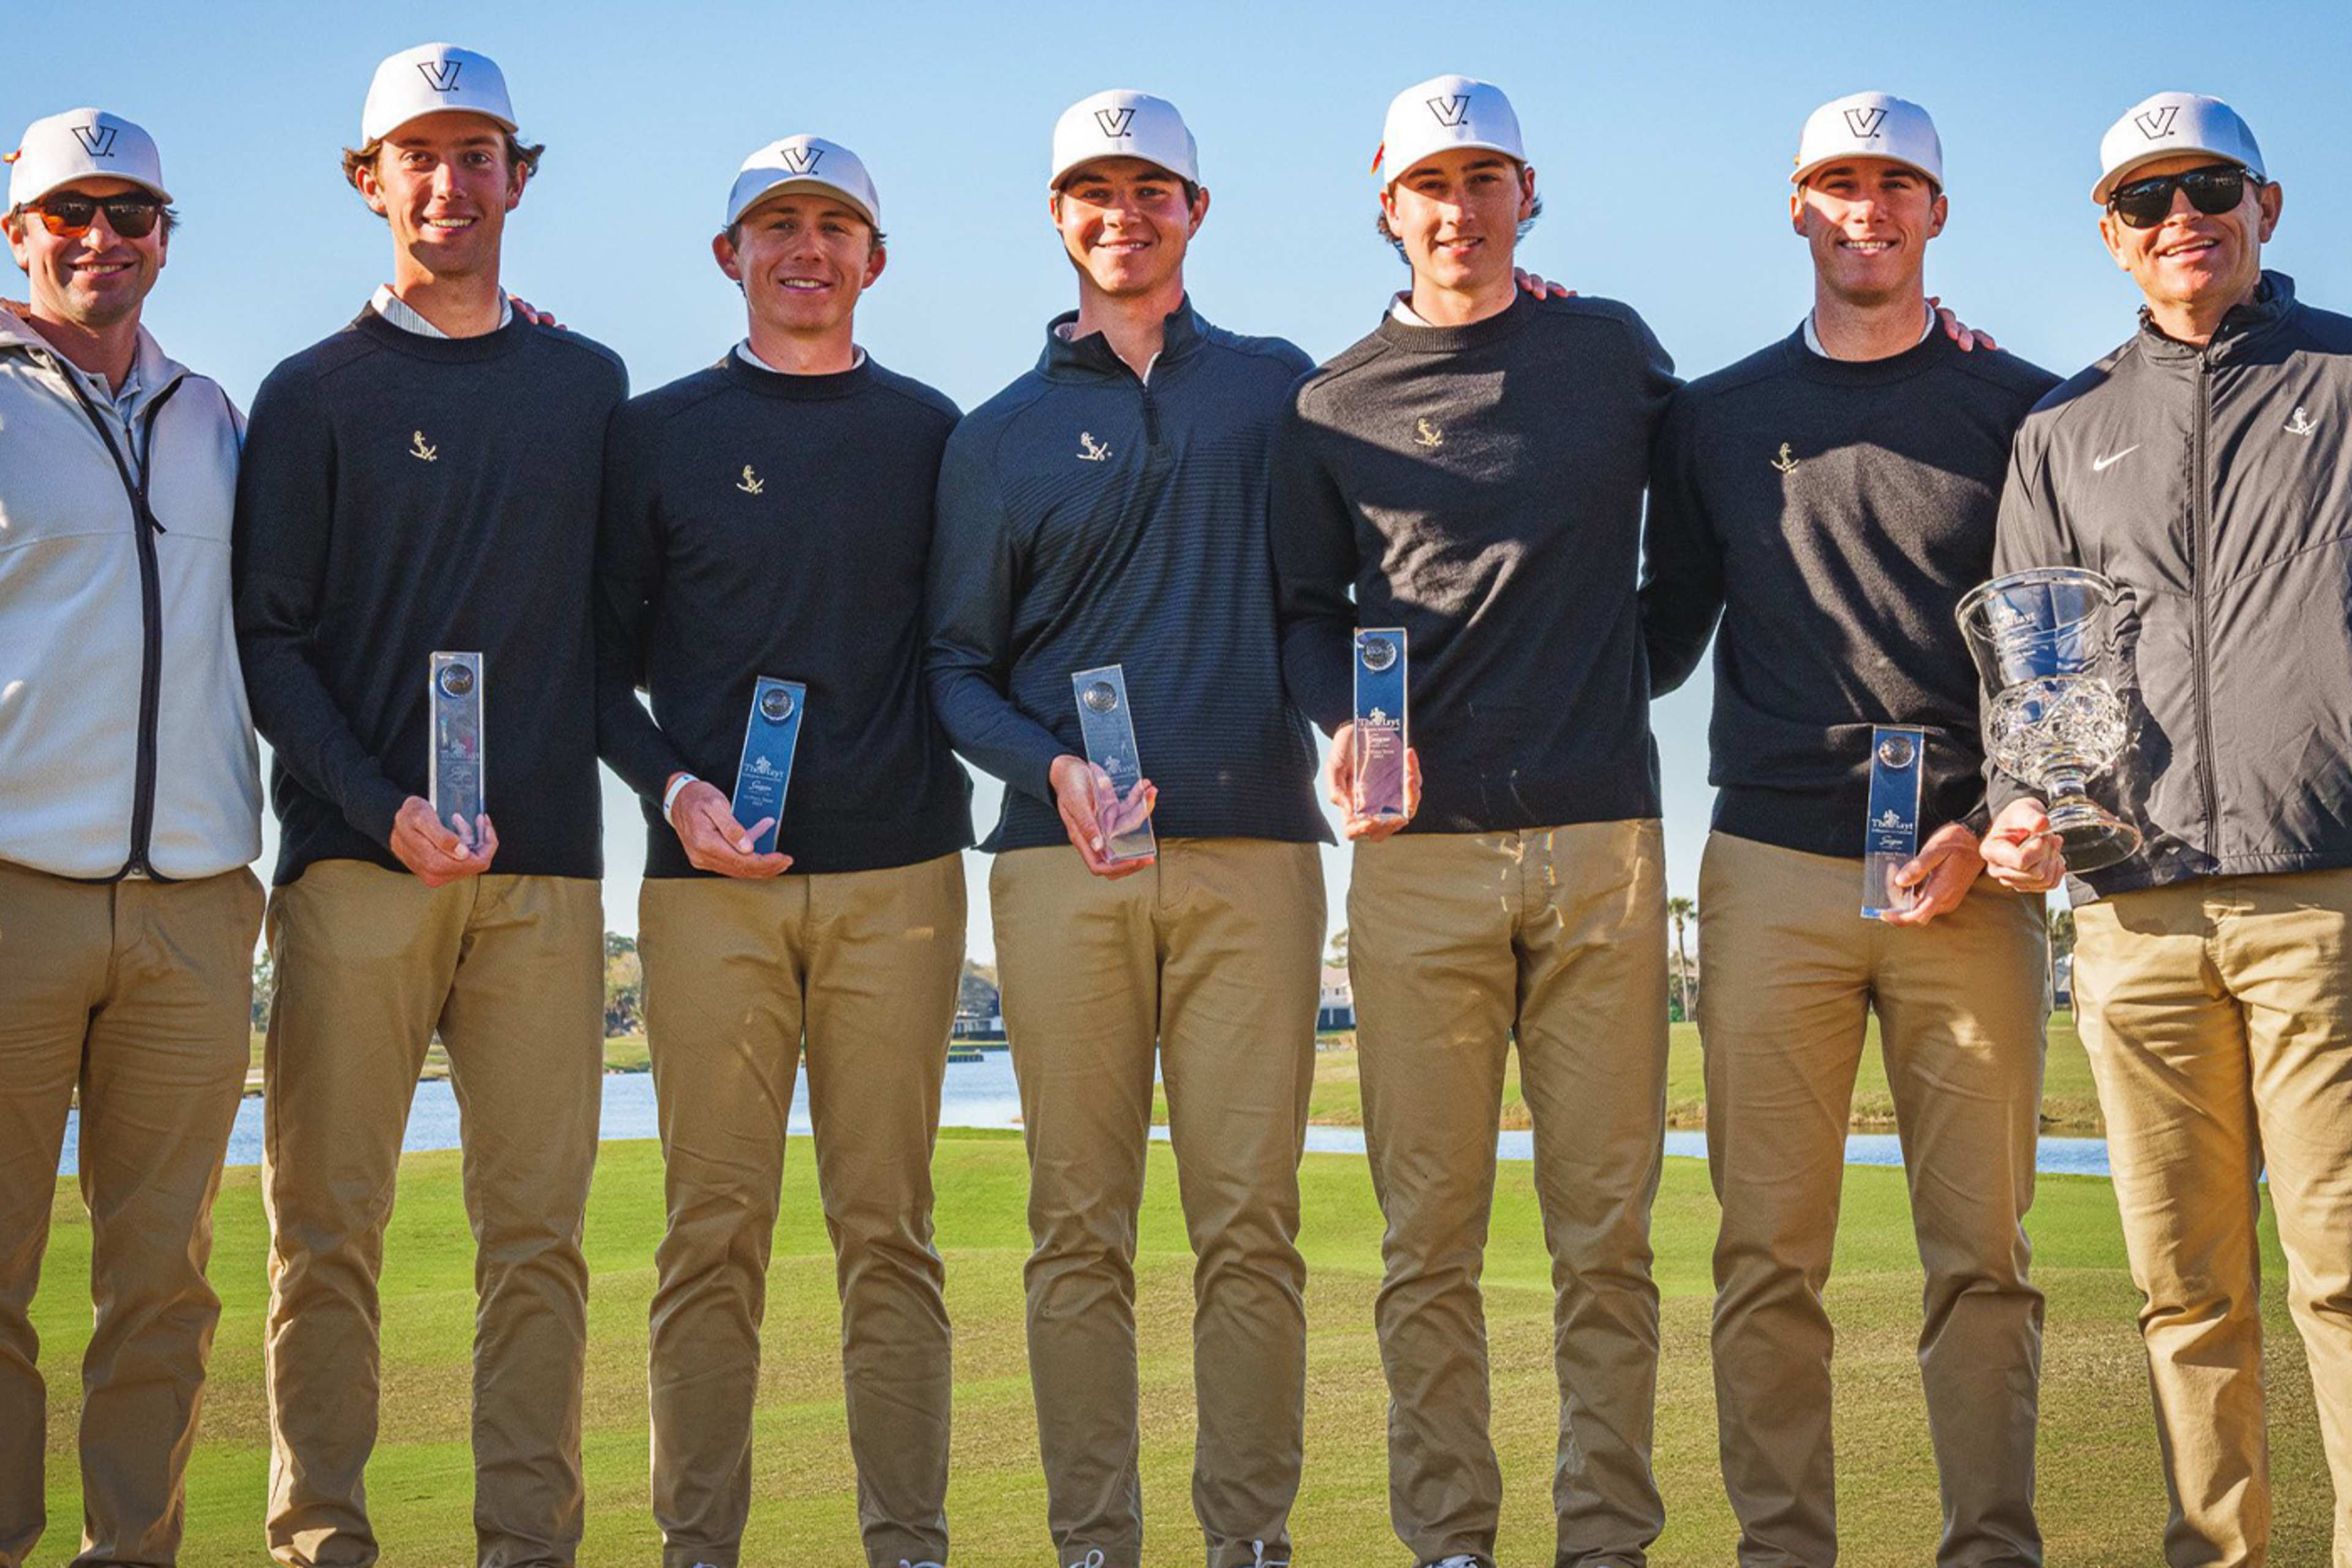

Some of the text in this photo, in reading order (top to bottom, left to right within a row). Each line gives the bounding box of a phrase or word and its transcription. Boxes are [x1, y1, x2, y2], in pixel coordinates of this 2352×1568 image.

[417, 61, 462, 91] V
[1095, 108, 1136, 138] V
[1426, 94, 1471, 127] V
[1844, 107, 1888, 138] V
[2135, 106, 2180, 140] V
[72, 126, 118, 157] V
[780, 146, 825, 175] V
